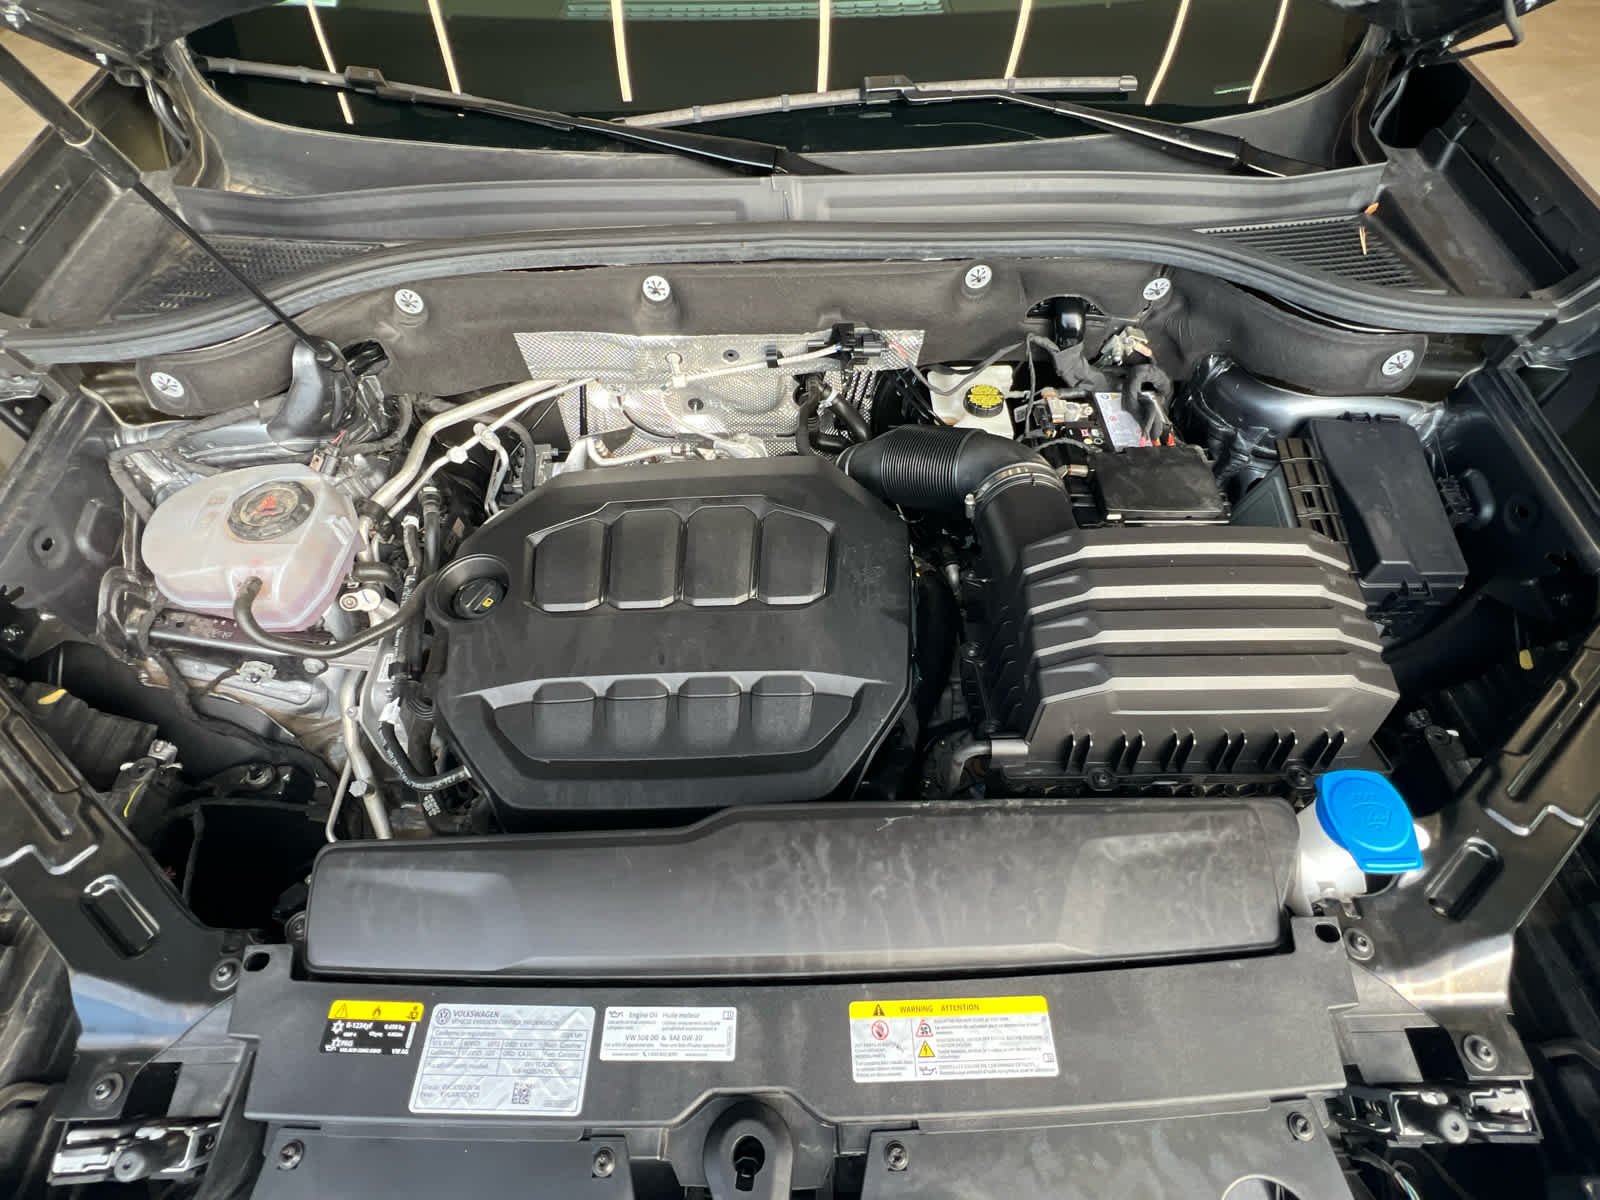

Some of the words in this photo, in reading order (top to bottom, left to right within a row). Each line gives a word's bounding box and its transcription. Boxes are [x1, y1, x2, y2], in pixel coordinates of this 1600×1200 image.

[899, 1005, 934, 1014] WARNING
[941, 1004, 980, 1012] ATTENTION
[452, 1010, 499, 1018] VOLKSWAGEN
